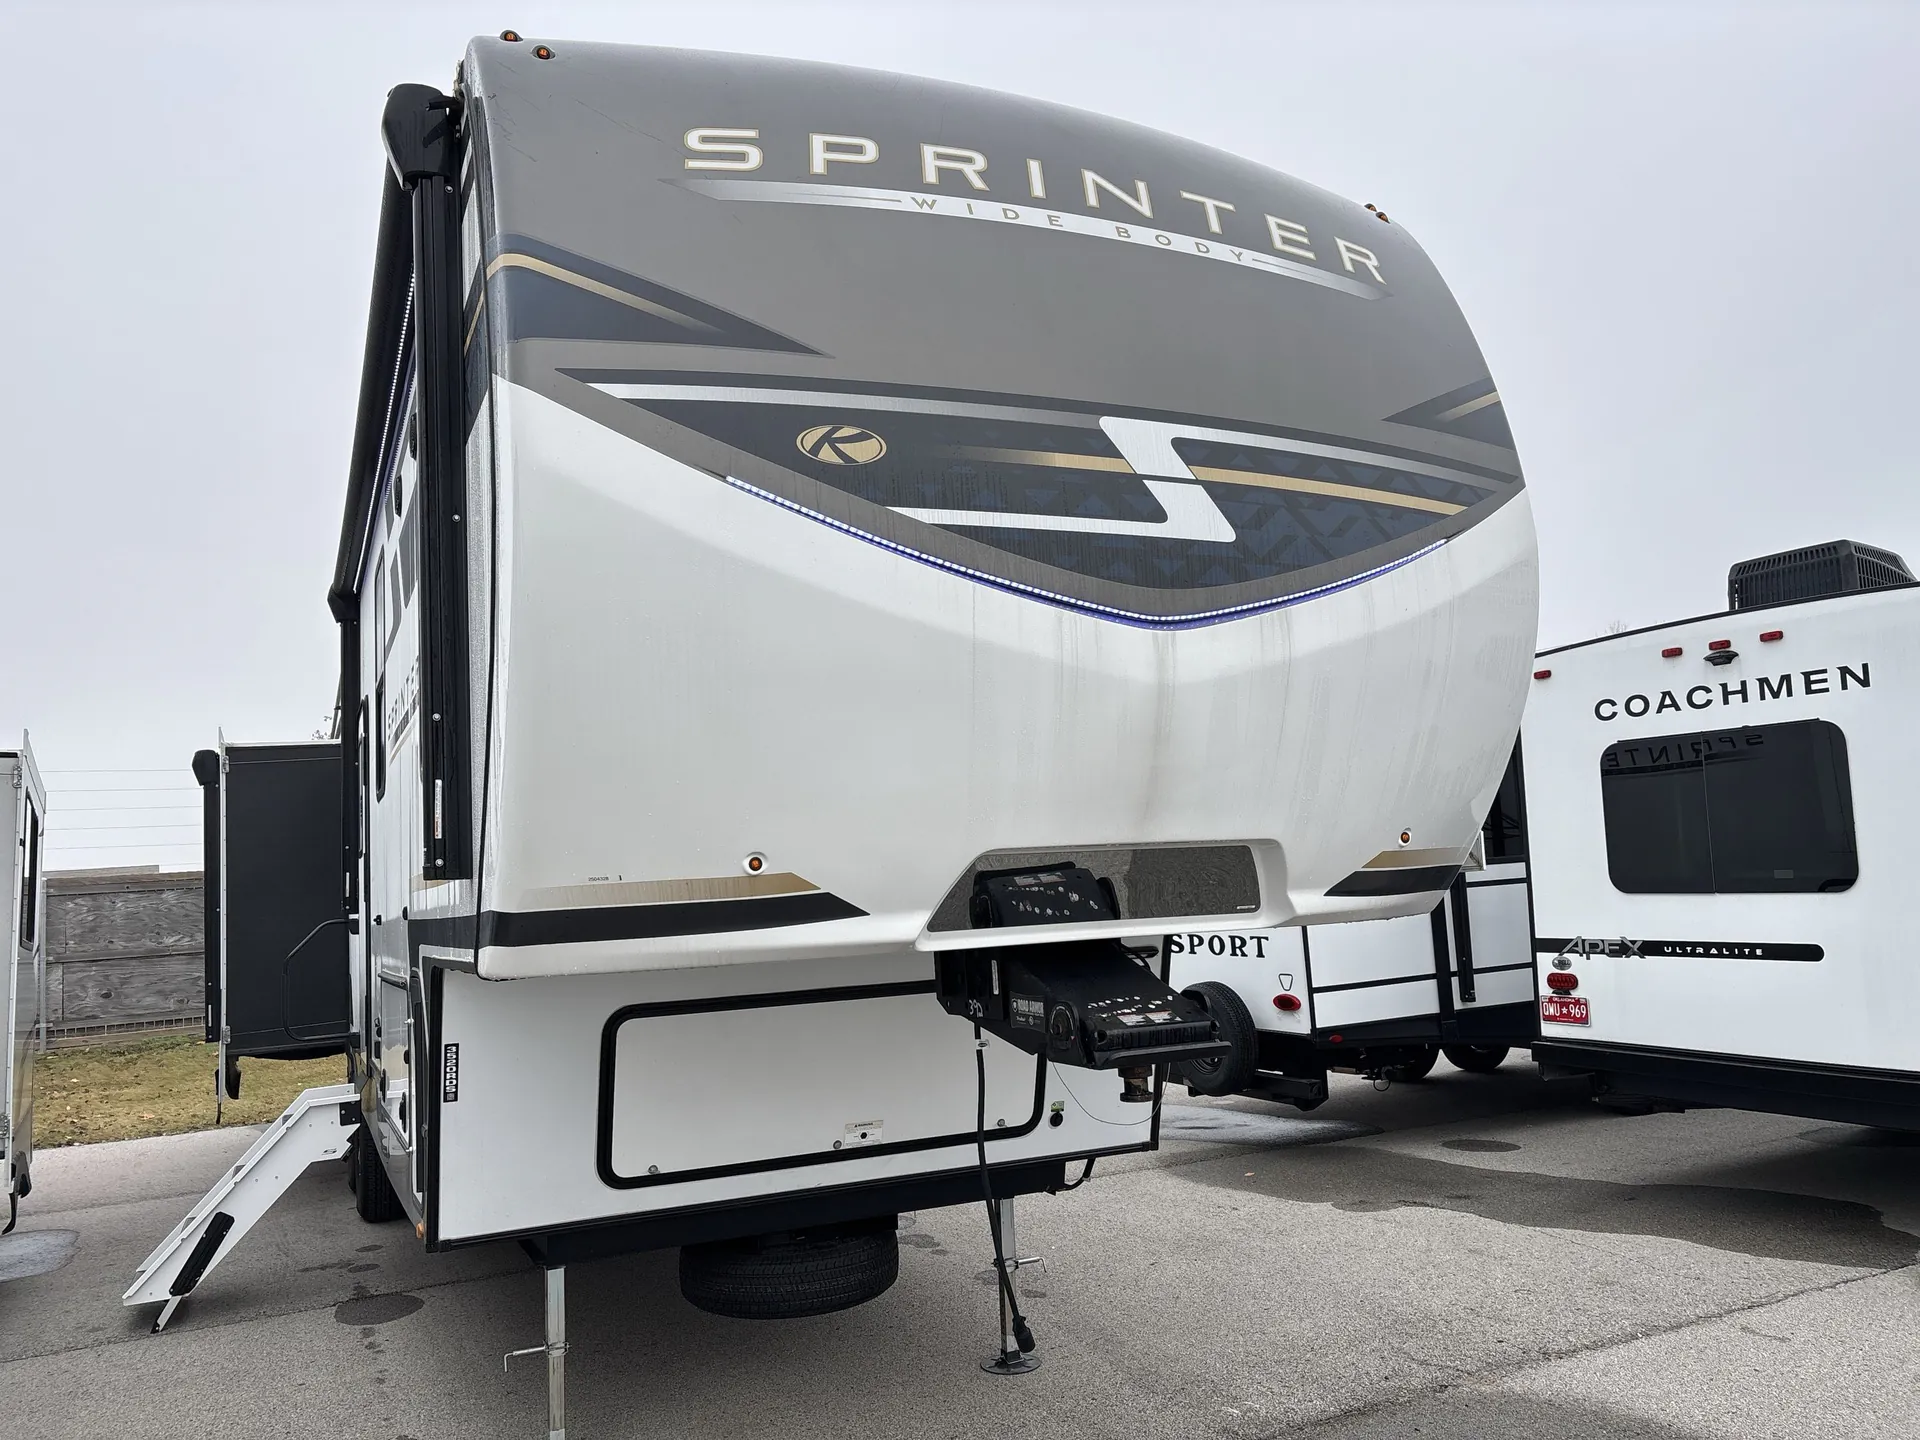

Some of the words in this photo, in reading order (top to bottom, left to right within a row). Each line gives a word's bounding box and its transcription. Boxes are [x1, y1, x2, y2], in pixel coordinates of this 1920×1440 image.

[683, 127, 1388, 285] SPRINTER
[910, 196, 1064, 228] WIDE
[1114, 225, 1245, 262] BODY
[1594, 662, 1871, 721] COACHMEN
[1169, 933, 1269, 958] SPORT
[1558, 936, 1646, 960] APEX
[1664, 946, 1763, 956] ULTRALITE
[1569, 1004, 1587, 1018] 969
